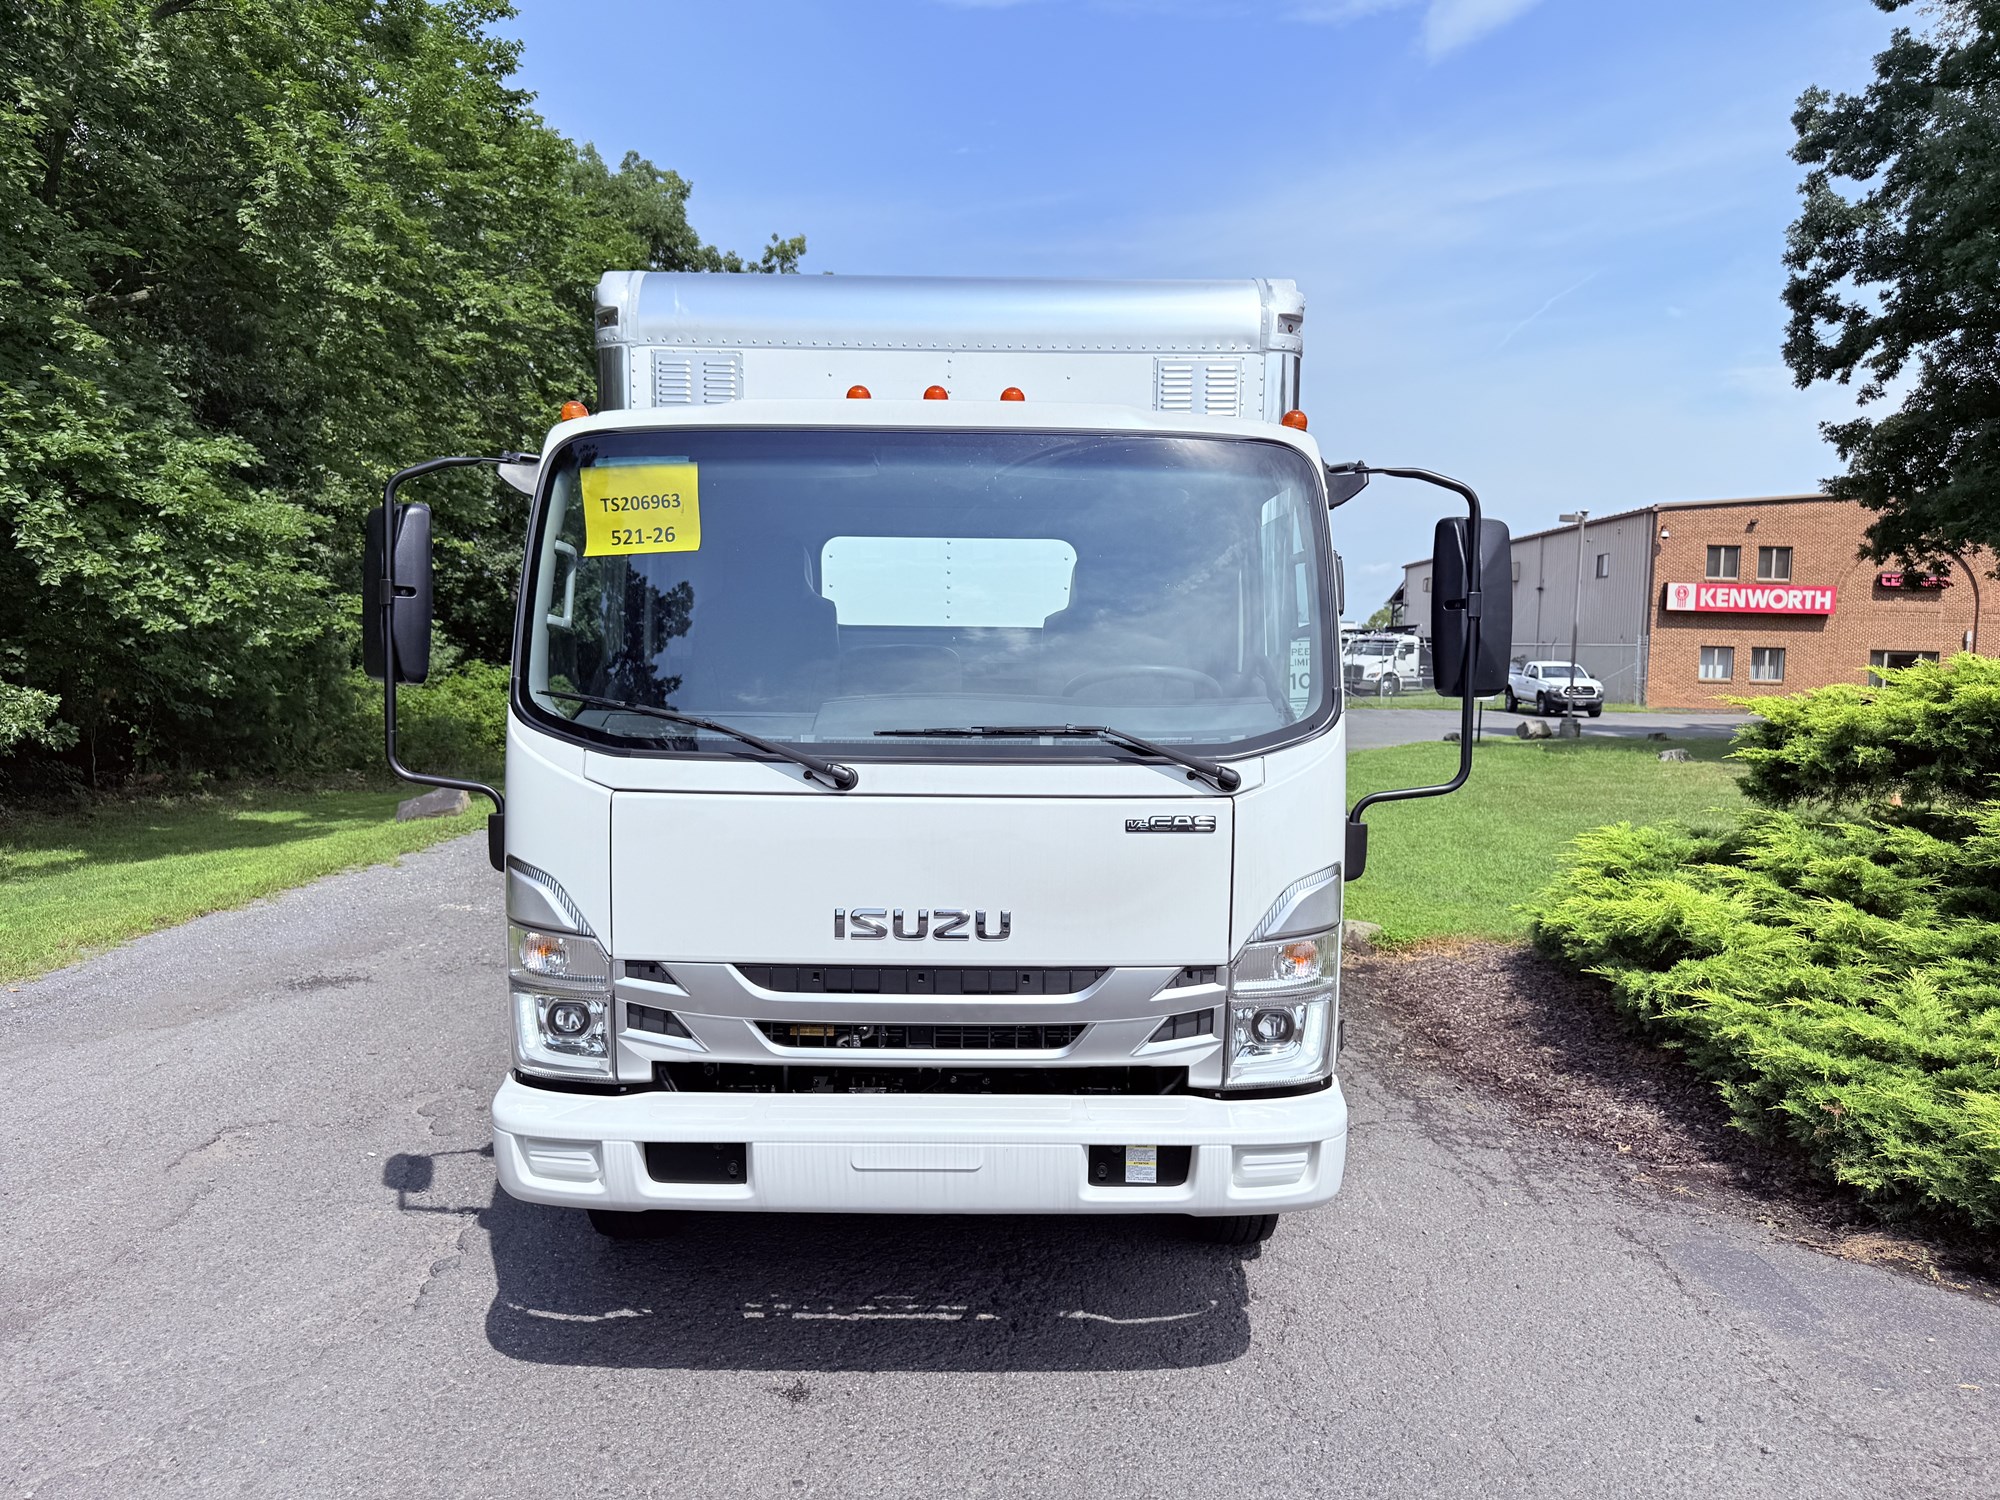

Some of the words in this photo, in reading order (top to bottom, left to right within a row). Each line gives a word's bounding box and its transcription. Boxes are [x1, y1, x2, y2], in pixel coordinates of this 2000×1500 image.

[600, 493, 681, 512] TS206963
[611, 527, 676, 546] 521-26
[1700, 587, 1832, 610] KENWORTH
[1291, 647, 1310, 656] PEE
[1150, 816, 1217, 831] GAS
[834, 907, 1012, 942] ISUZU
